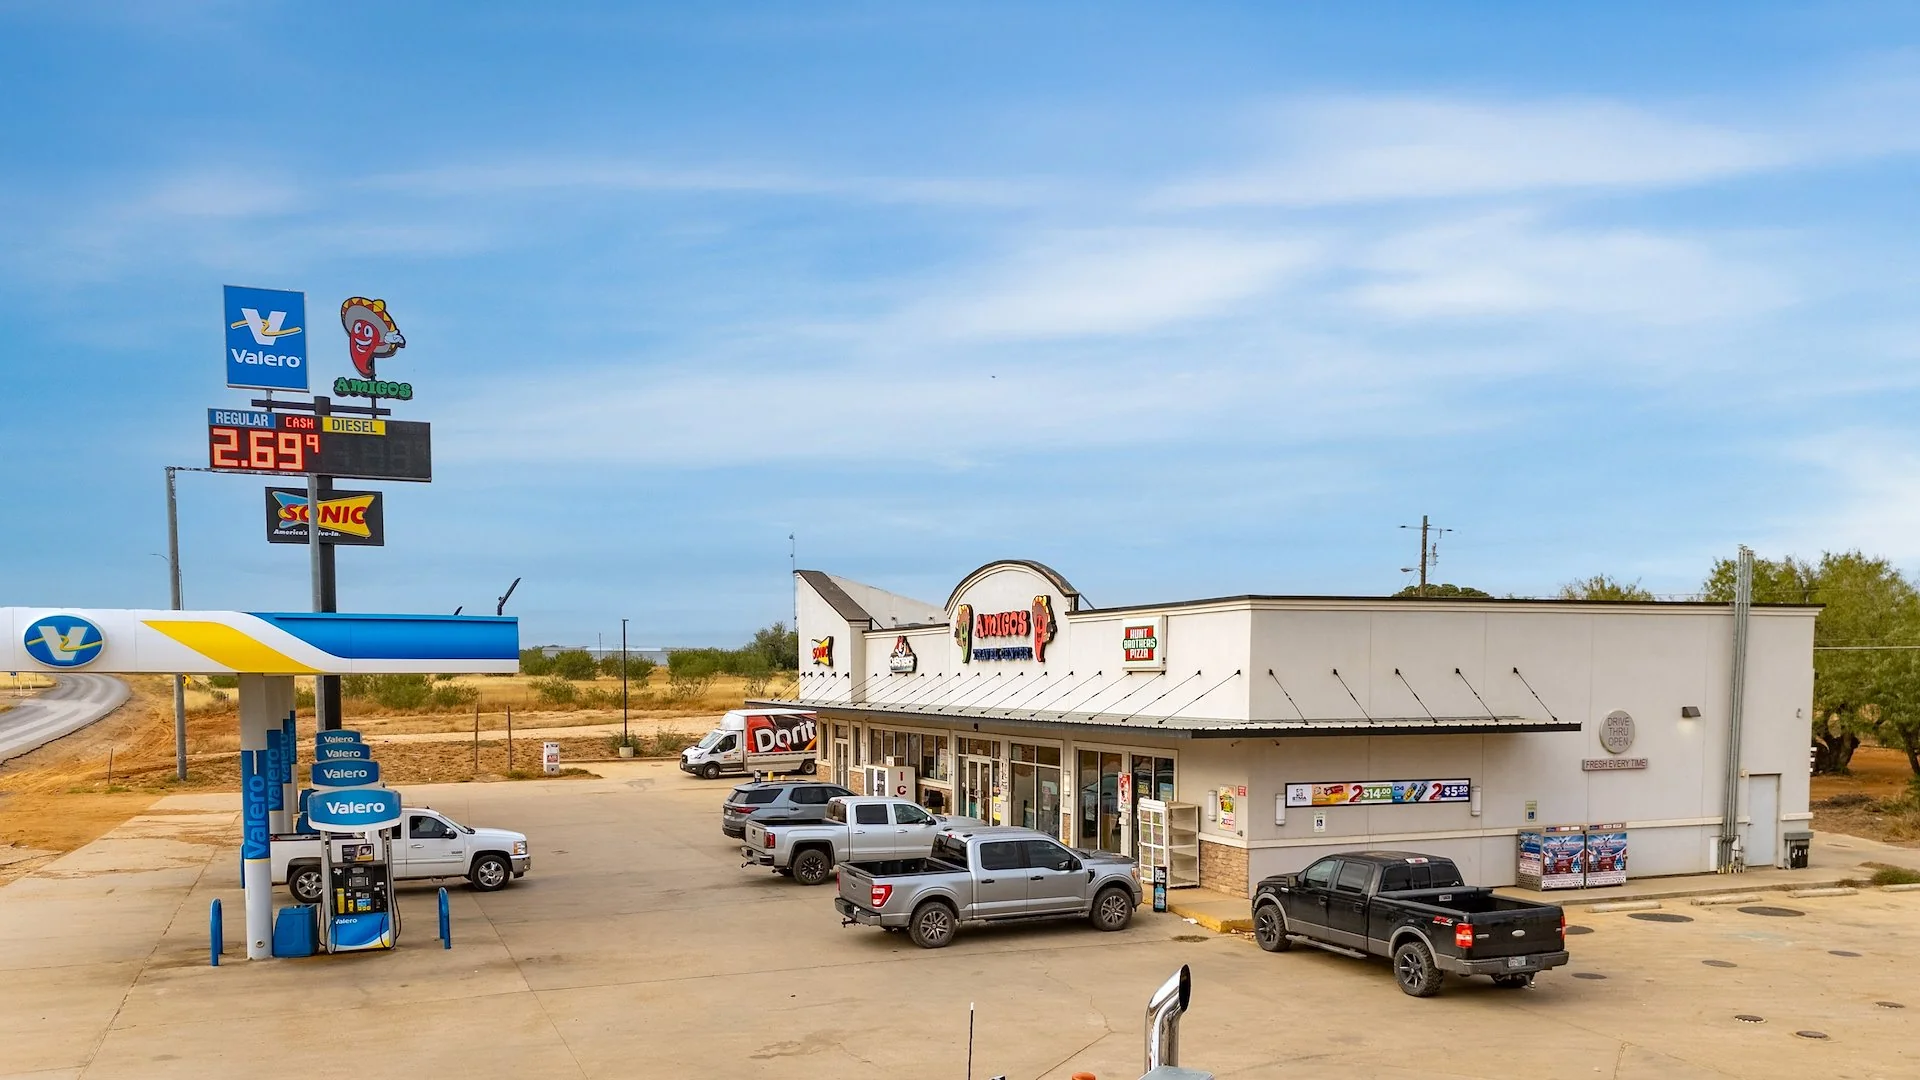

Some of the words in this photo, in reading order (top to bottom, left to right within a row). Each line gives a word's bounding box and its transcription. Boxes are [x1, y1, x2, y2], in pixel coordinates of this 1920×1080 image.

[231, 348, 301, 368] Valero
[334, 376, 413, 399] AMIGOS
[215, 411, 269, 427] REGULAR
[285, 416, 314, 429] CASH
[332, 418, 377, 433] DIESEL
[273, 528, 308, 536] America's
[975, 610, 1031, 638] AMIGOS
[1130, 628, 1148, 638] HUNT
[1123, 637, 1156, 650] BROTHERS
[1000, 646, 1032, 661] CENTER
[1130, 649, 1148, 659] PIZZA
[1607, 716, 1630, 727] DRIVE
[754, 720, 816, 753] Dorit
[1608, 727, 1629, 737] THRU
[324, 736, 354, 744] Valero
[1608, 736, 1629, 747] OPEN
[325, 749, 361, 758] Valero
[1585, 760, 1607, 769] FRESH
[1608, 759, 1630, 768] EVERY
[323, 768, 368, 779] Valero
[1349, 784, 1364, 802] 2
[1363, 787, 1391, 800] $14.00
[1429, 782, 1444, 801] 2
[1444, 785, 1468, 797] $5.50
[326, 802, 385, 815] Valero
[247, 775, 266, 859] Valero
[335, 917, 357, 925] Valero
